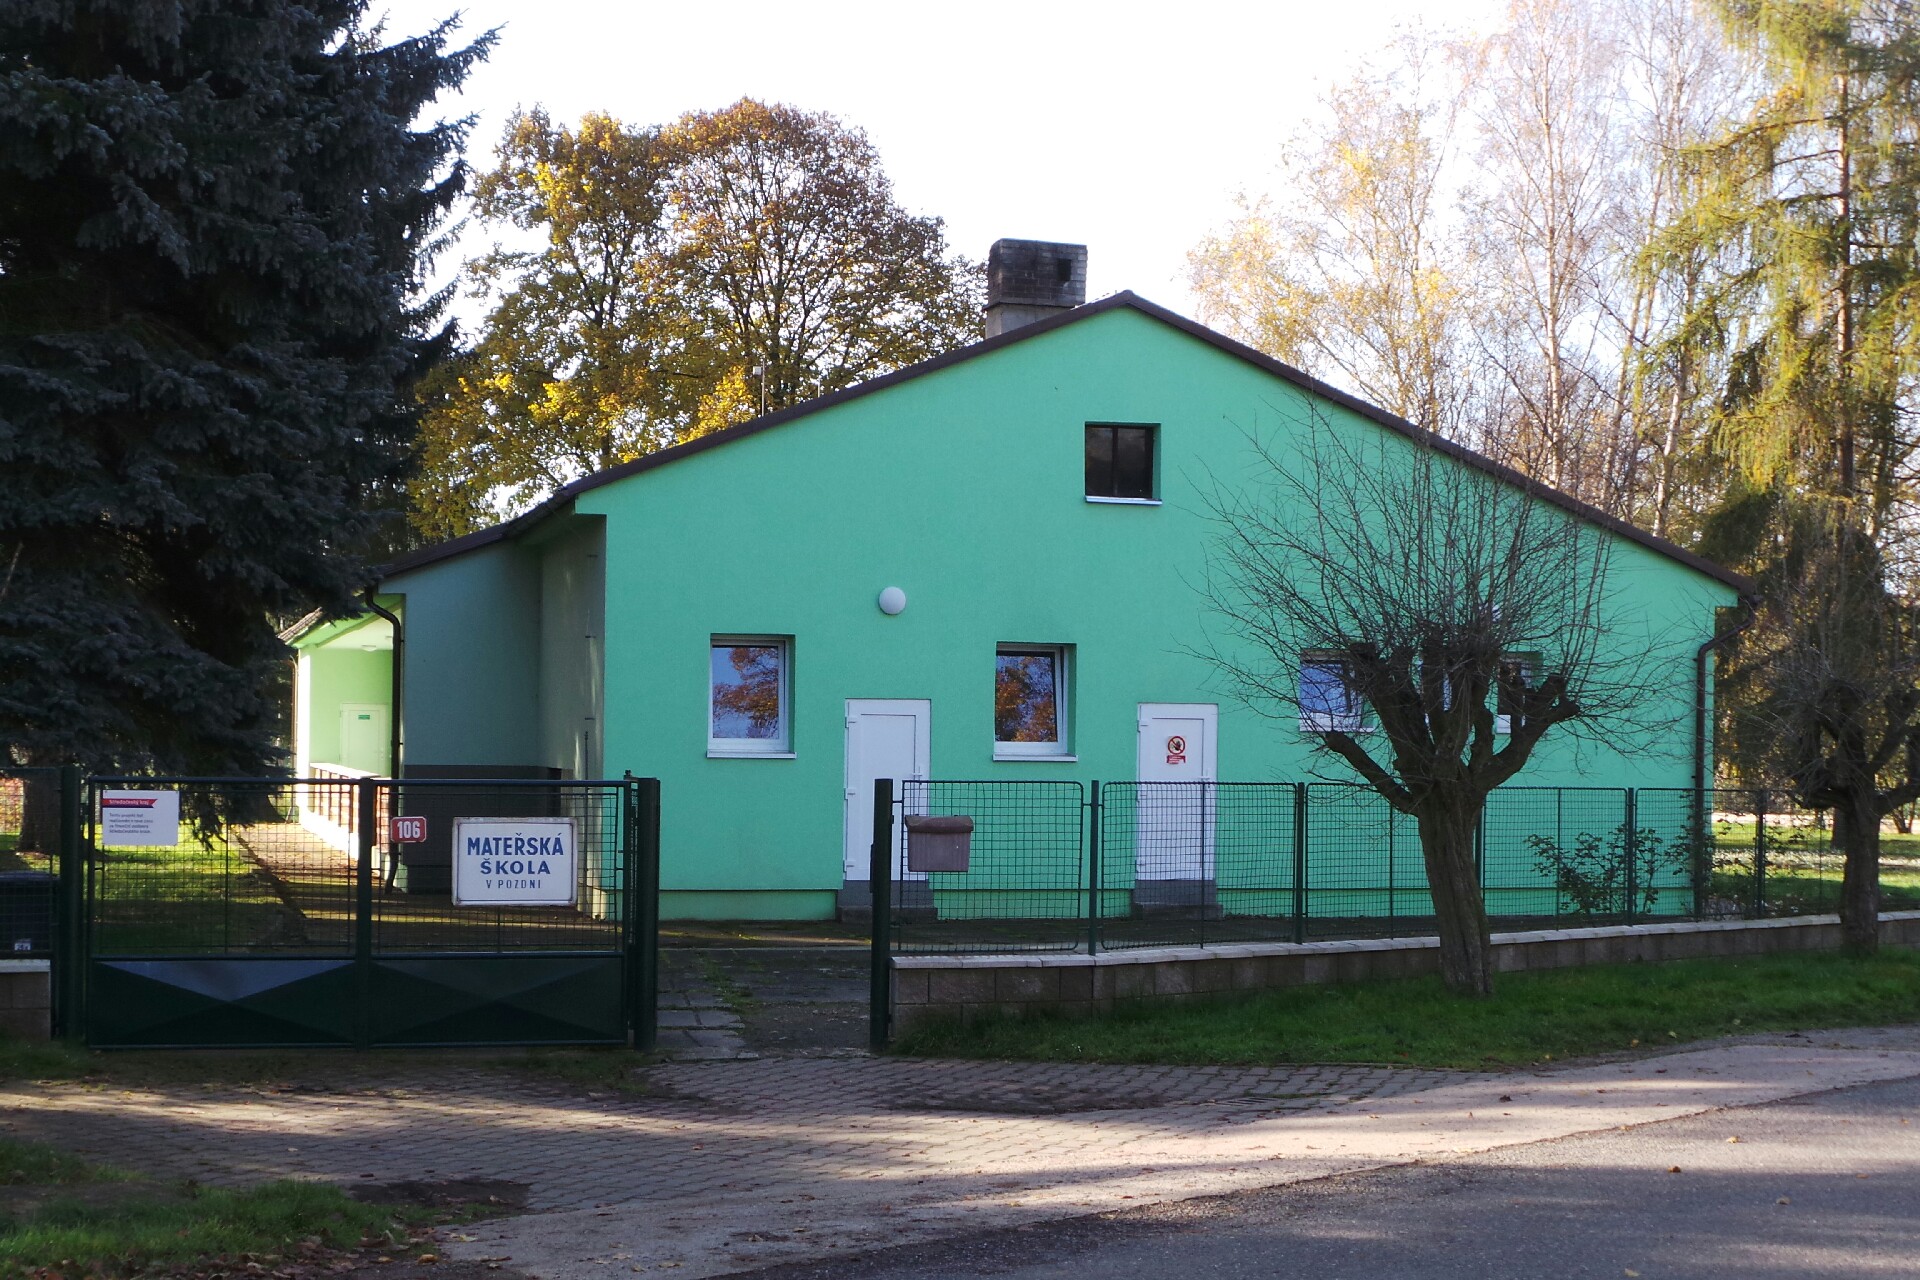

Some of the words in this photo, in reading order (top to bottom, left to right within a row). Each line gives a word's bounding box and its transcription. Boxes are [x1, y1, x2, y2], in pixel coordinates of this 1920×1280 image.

[397, 821, 420, 838] 106
[467, 833, 564, 855] MATEŘSKÁ
[480, 858, 551, 874] ŠKOLA
[486, 880, 492, 888] V
